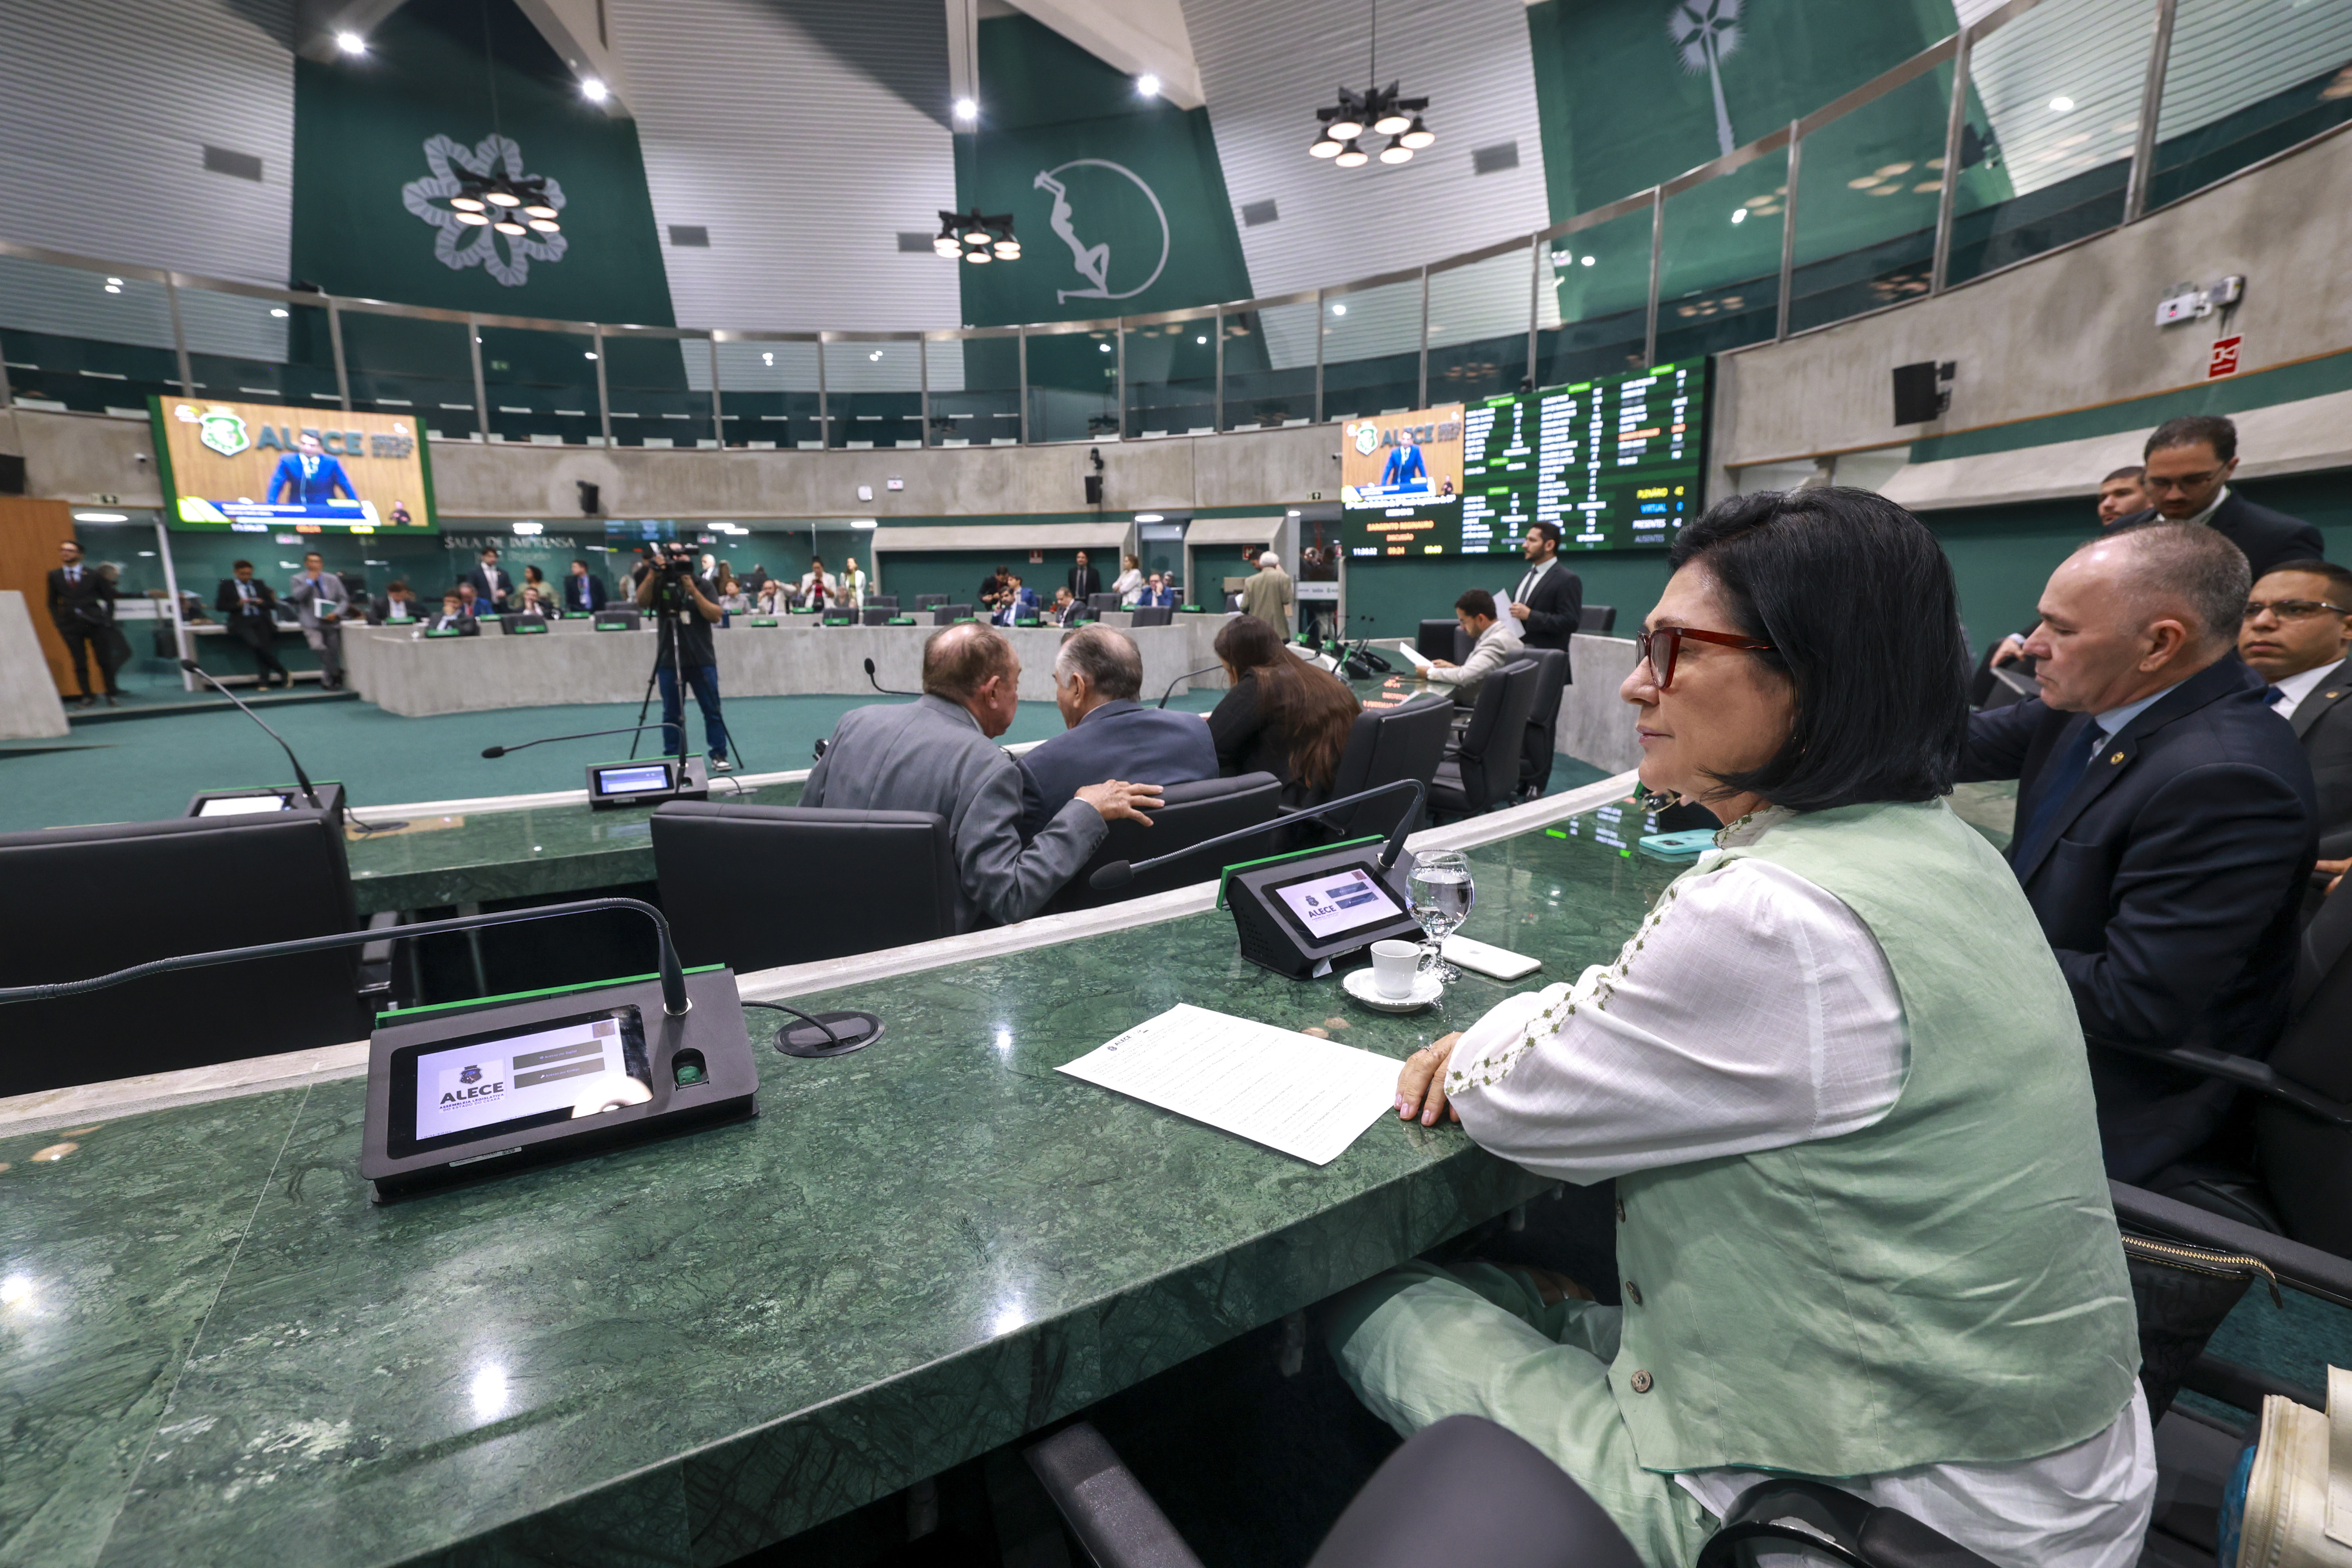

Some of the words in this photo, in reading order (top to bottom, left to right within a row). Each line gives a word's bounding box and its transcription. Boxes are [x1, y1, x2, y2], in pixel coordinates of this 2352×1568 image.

[256, 425, 364, 456] ALCE
[1381, 425, 1434, 448] ALCE
[1637, 487, 1668, 499] PLENÁRIO
[1640, 503, 1668, 514] VIRTUAL
[1367, 522, 1399, 532] SARGENTO
[1632, 518, 1666, 529] PRESENTES
[1634, 534, 1665, 543] AUSENTES
[1308, 905, 1337, 918] ALECE
[1114, 1035, 1132, 1046] ALECE
[440, 1082, 504, 1105] ALECE
[439, 1100, 470, 1109] ASSEMBLEIA
[472, 1093, 504, 1102] LEGISLATIVA
